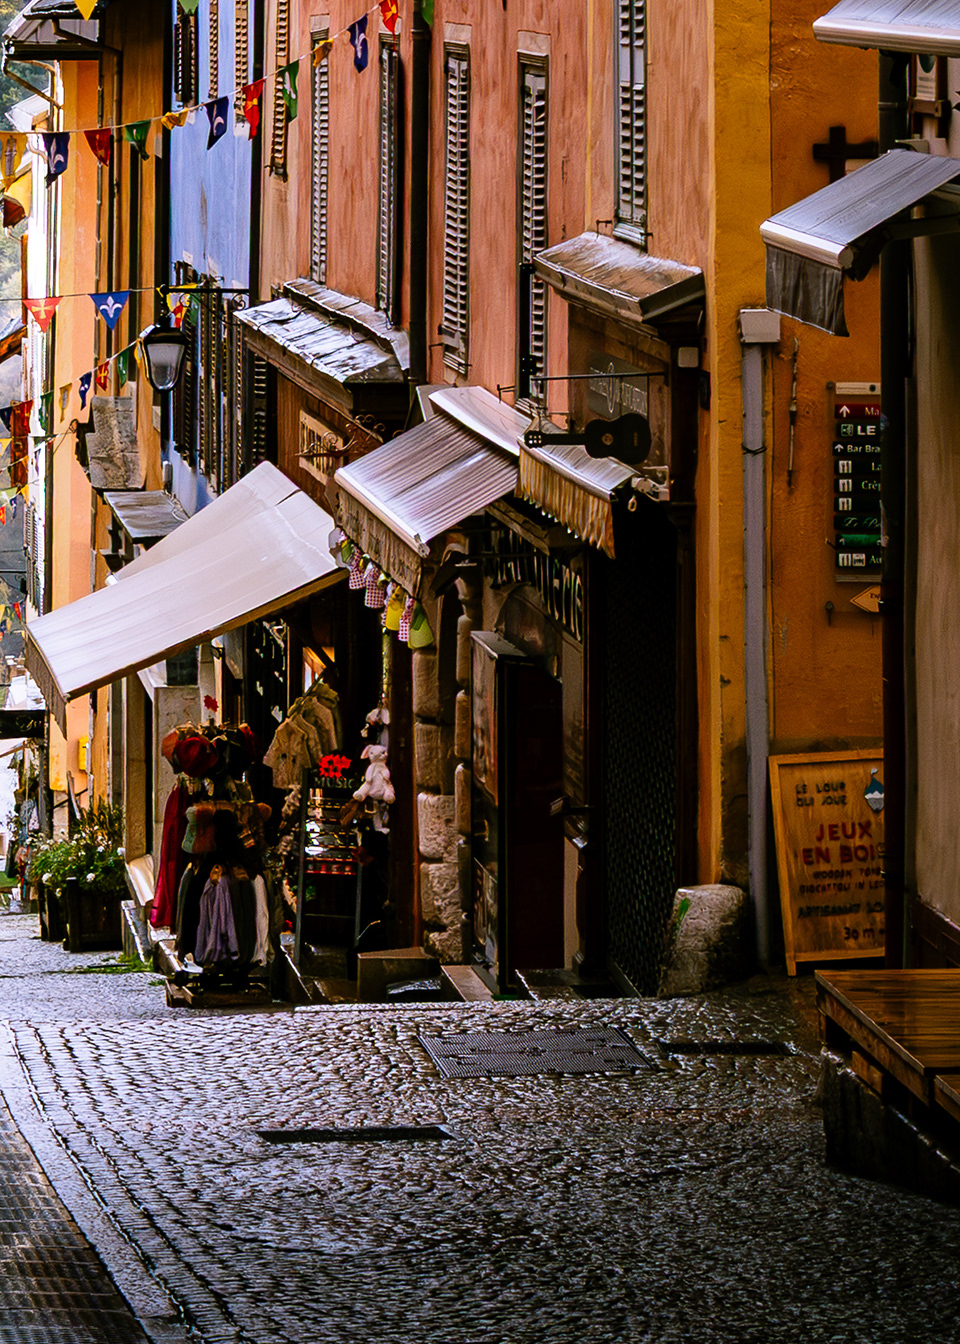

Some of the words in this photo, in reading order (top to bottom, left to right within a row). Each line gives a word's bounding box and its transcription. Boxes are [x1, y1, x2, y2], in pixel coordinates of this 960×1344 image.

[857, 425, 877, 436] LE
[847, 444, 863, 453] Bar
[795, 783, 808, 795] LE
[816, 820, 873, 842] JEUX
[802, 846, 831, 866] EN
[840, 843, 880, 864] BOI
